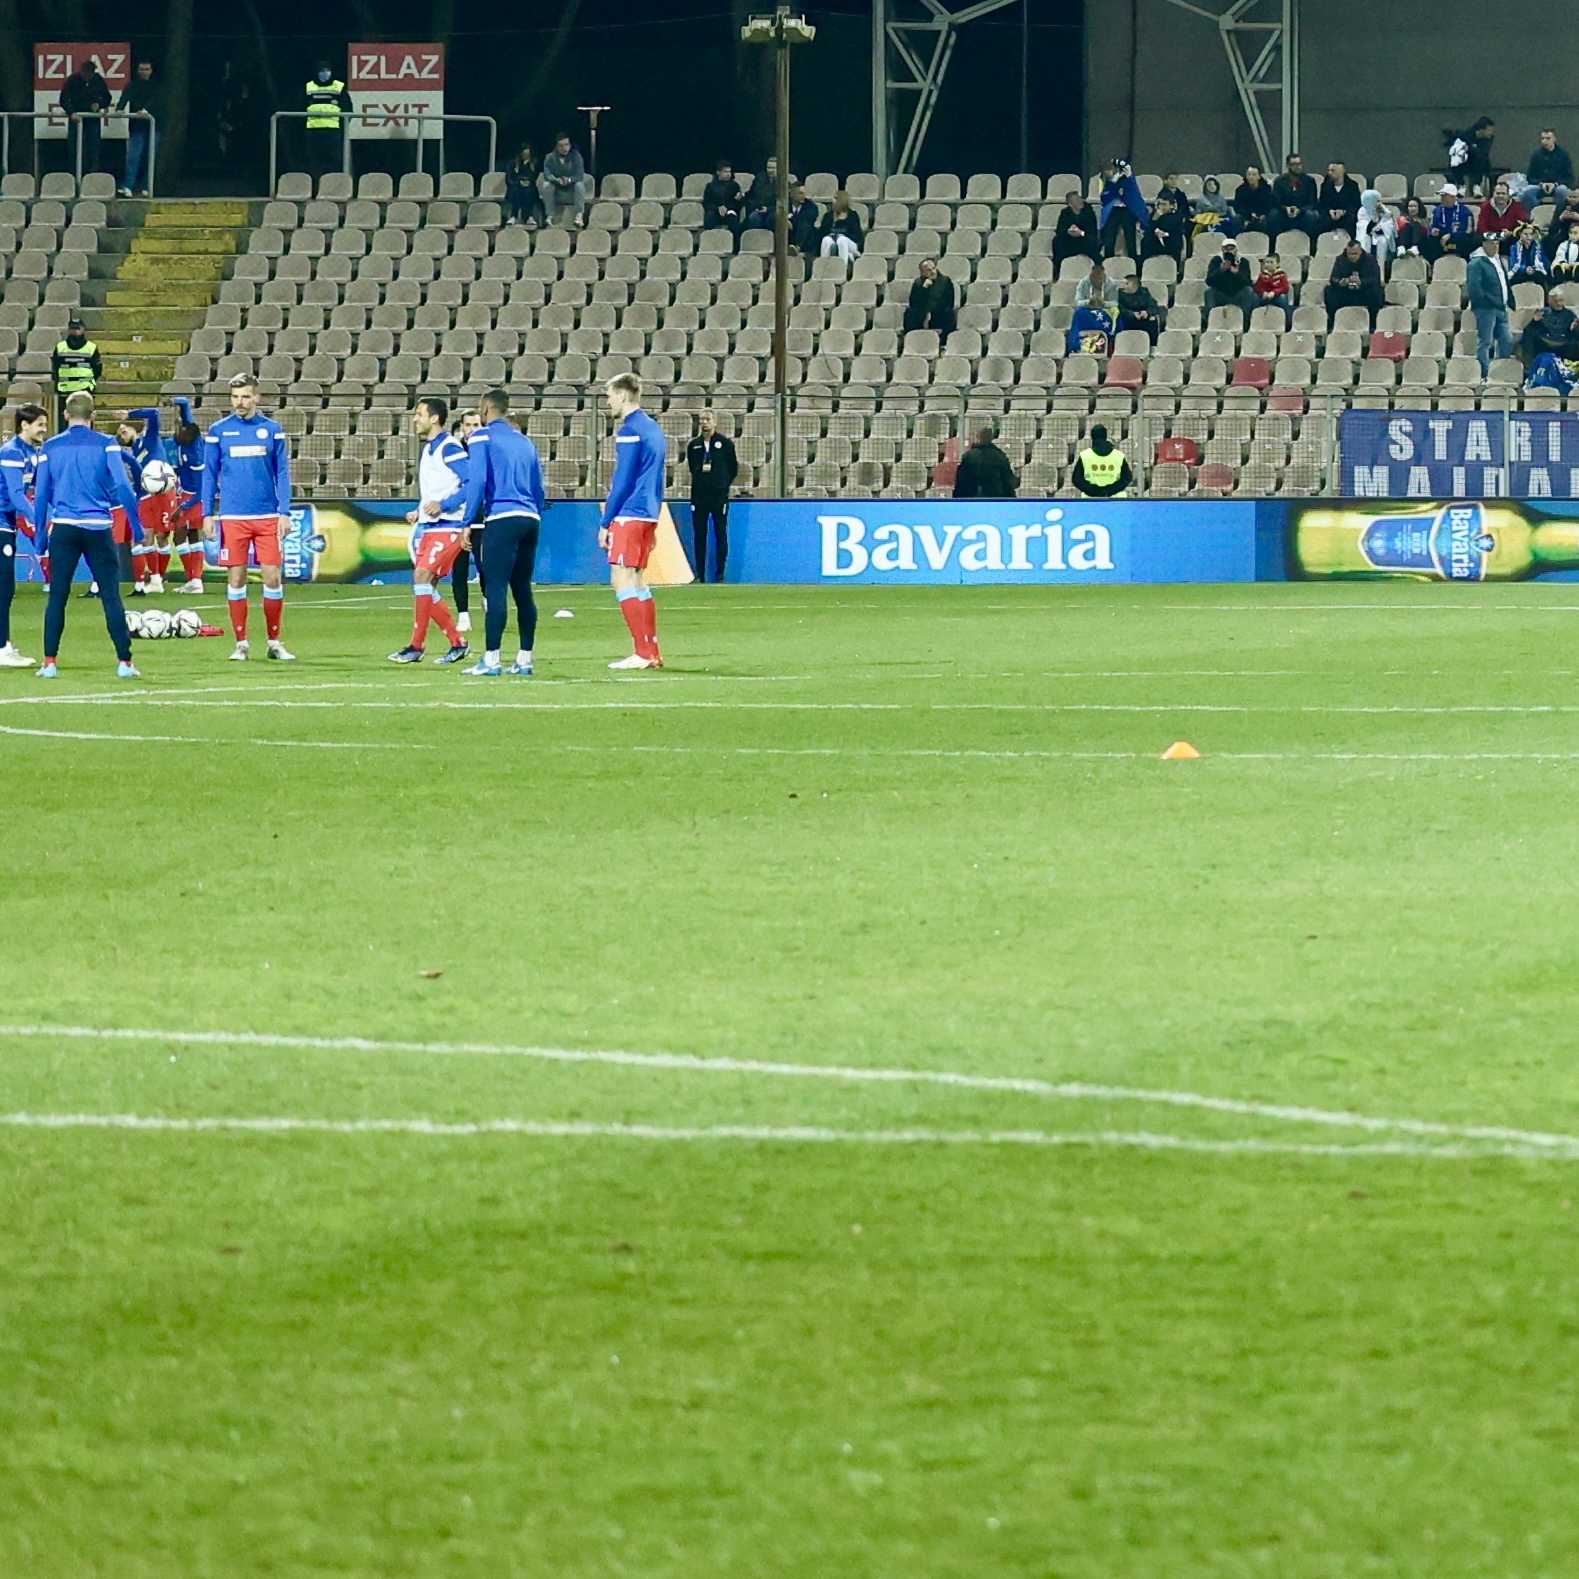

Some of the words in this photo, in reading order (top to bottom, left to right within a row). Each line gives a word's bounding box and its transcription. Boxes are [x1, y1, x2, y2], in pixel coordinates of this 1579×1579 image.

[351, 54, 440, 80] IZLAZ
[361, 103, 430, 127] EXIT
[1388, 418, 1561, 462] STARI
[816, 507, 1115, 577] Bavaria
[1450, 507, 1475, 578] Bavaria
